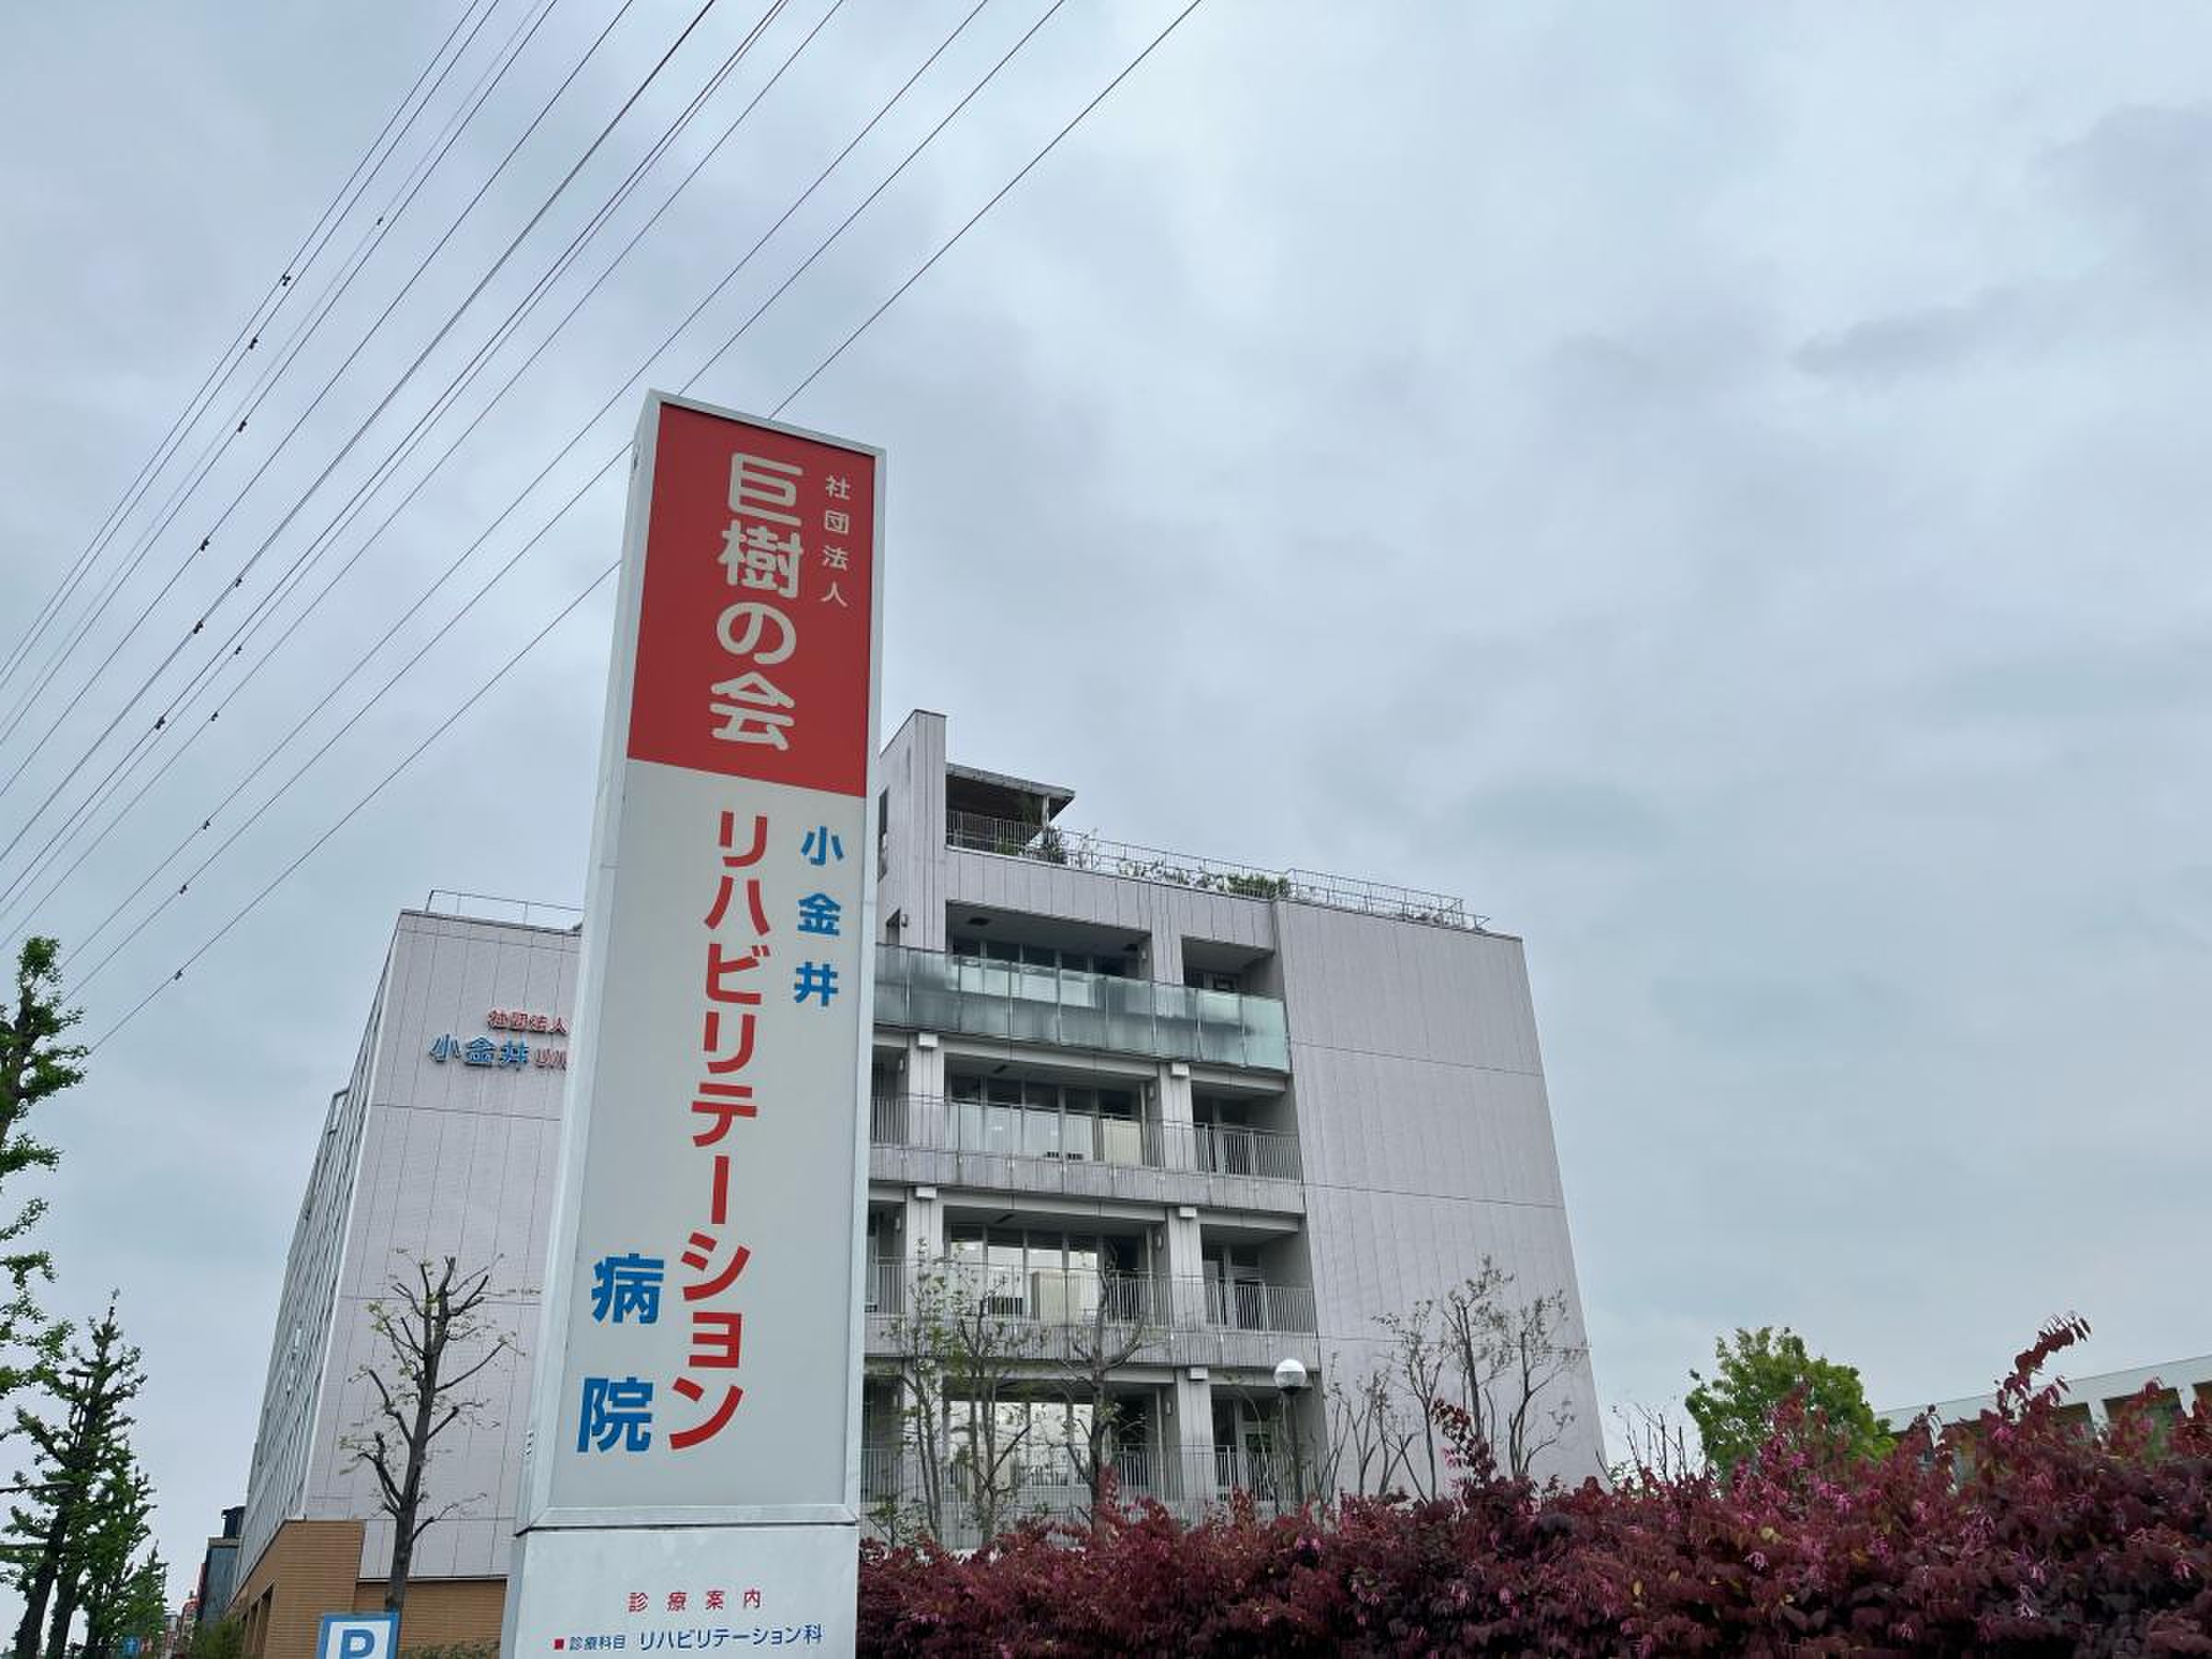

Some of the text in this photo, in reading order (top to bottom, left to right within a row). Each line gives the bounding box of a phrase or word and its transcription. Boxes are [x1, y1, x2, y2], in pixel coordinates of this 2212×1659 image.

[710, 452, 805, 751] 巨樹の会
[821, 475, 851, 608] 社団法人
[793, 825, 845, 1007] 小金井
[668, 810, 771, 1451] リハビリテーション
[576, 1252, 665, 1454] 病院
[339, 1629, 376, 1659] P
[570, 1623, 824, 1652] 診療科目 リハビリテーション科
[628, 1588, 762, 1613] 診療案内
